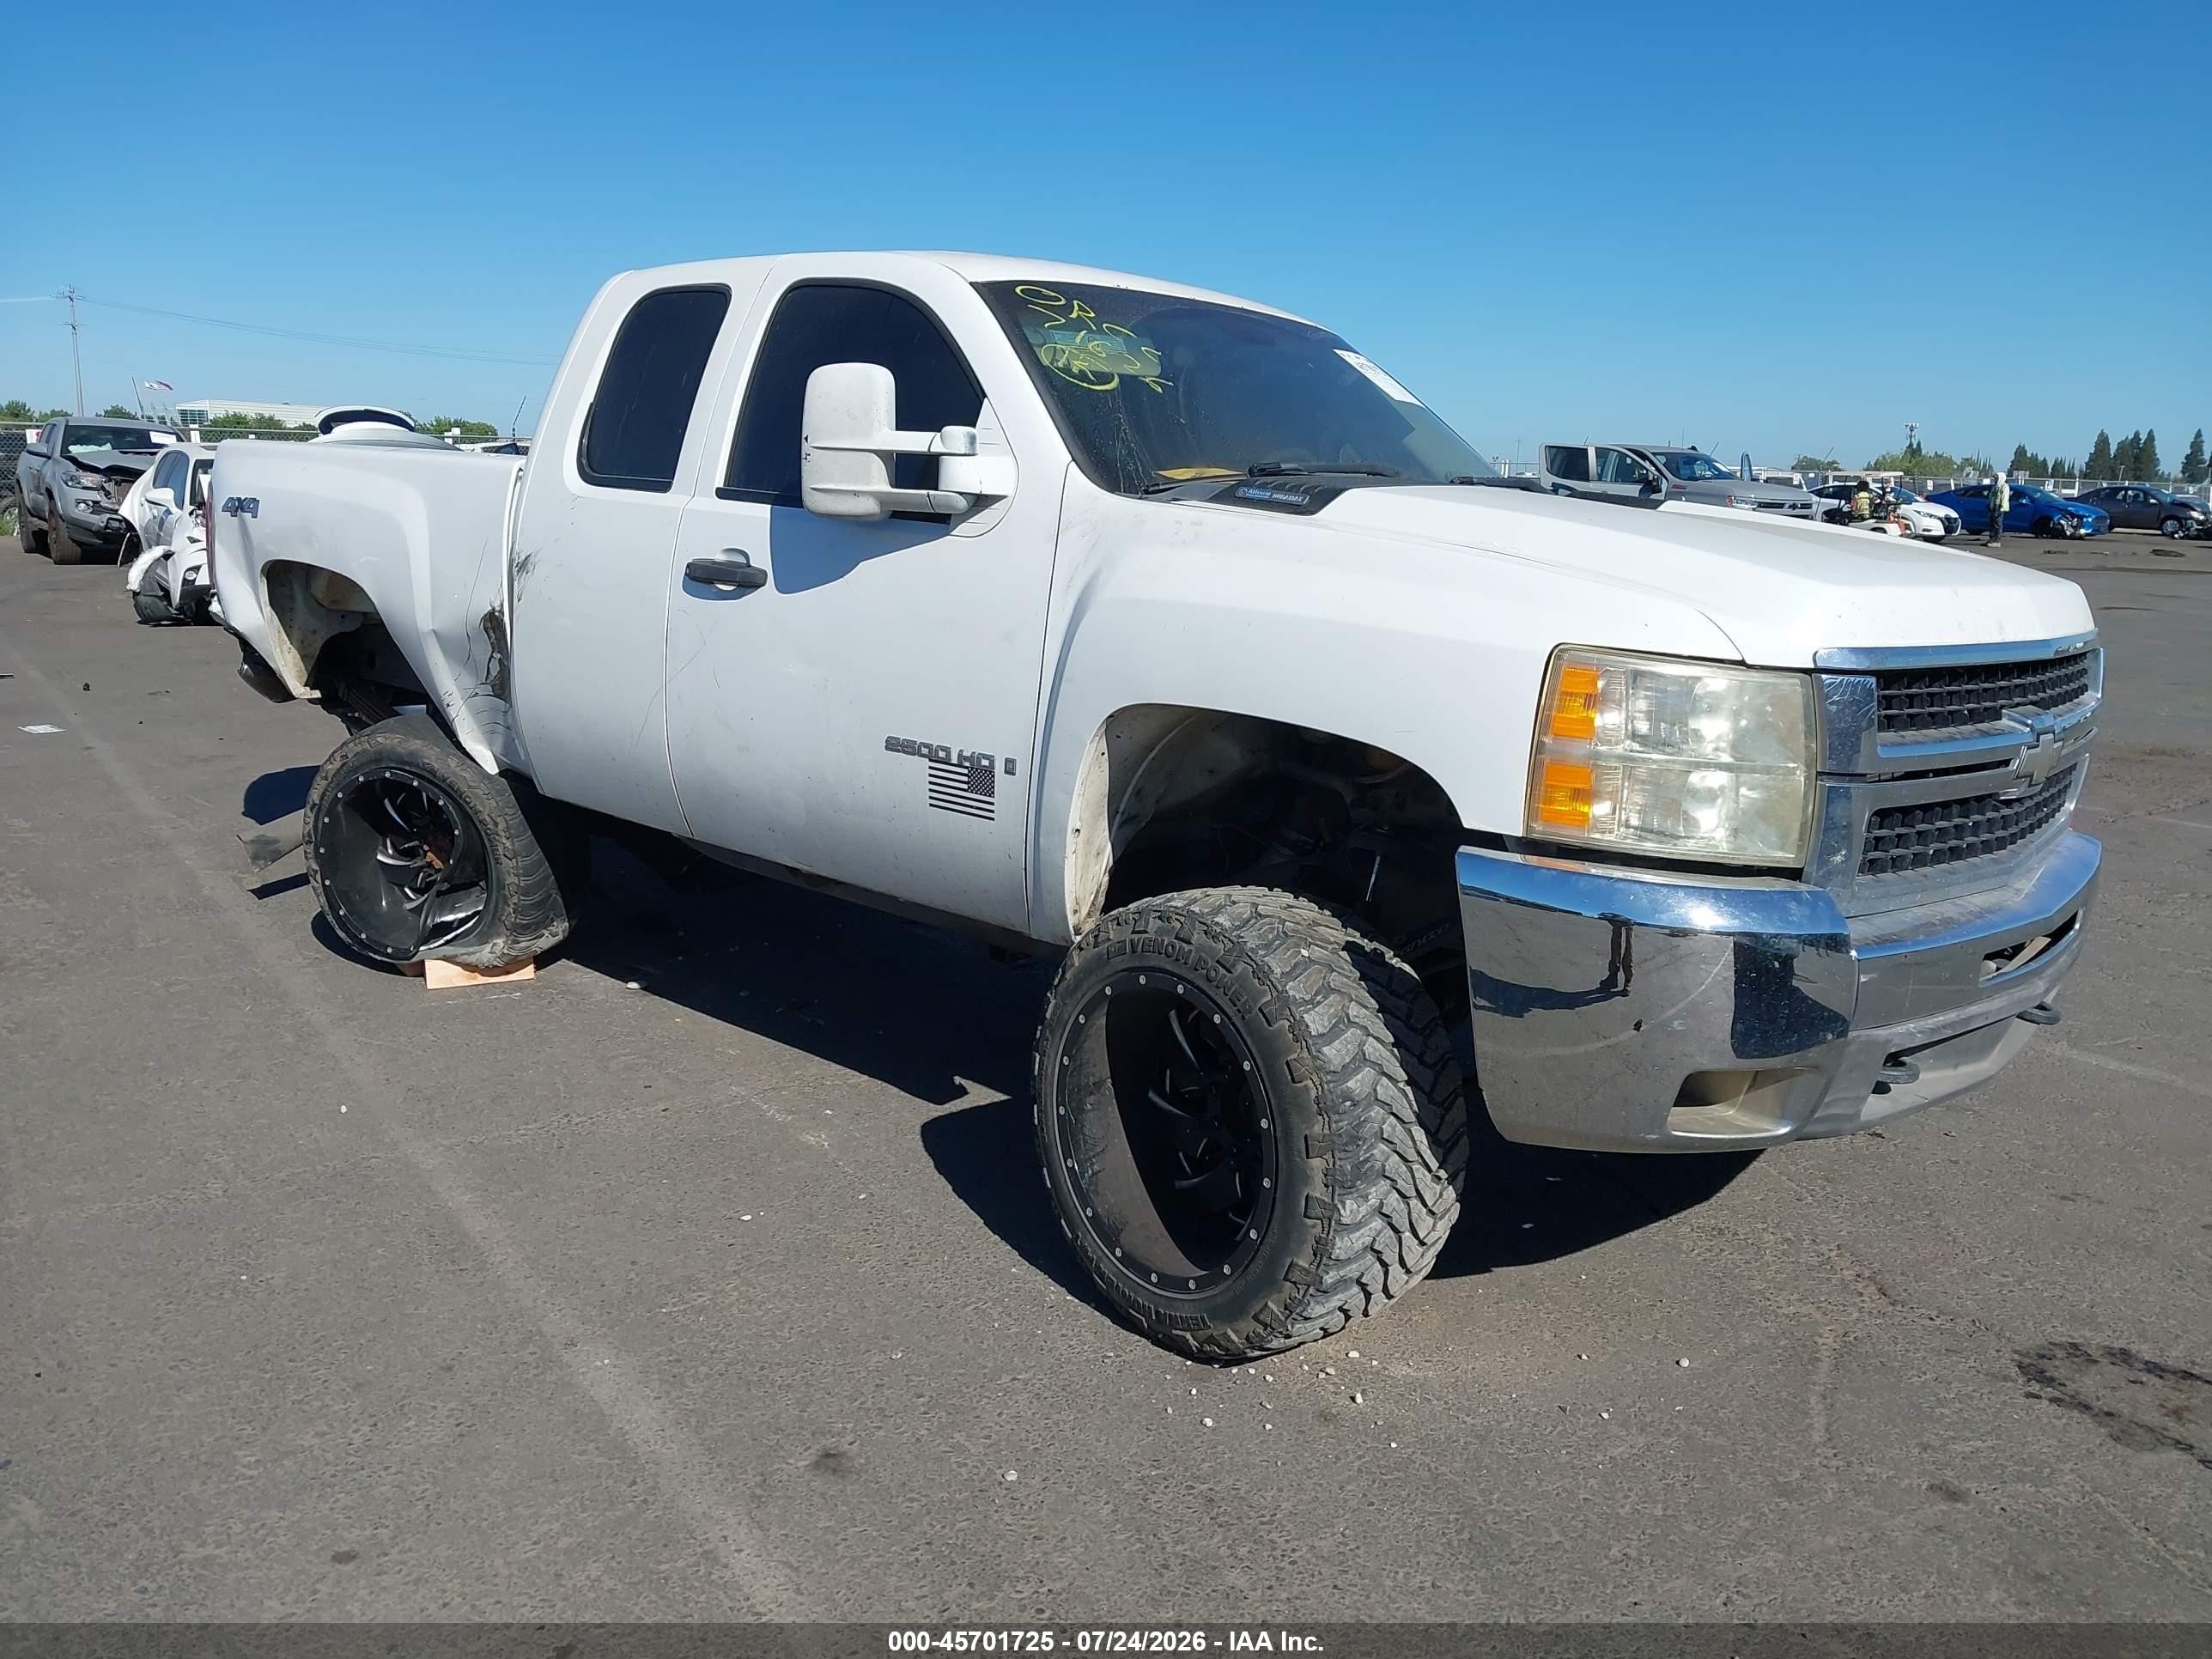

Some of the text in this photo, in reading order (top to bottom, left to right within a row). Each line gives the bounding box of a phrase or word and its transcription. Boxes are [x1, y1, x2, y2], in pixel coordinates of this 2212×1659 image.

[884, 735, 952, 763] 2500
[957, 749, 996, 771] HD
[1129, 937, 1255, 1020] VENOM POWER
